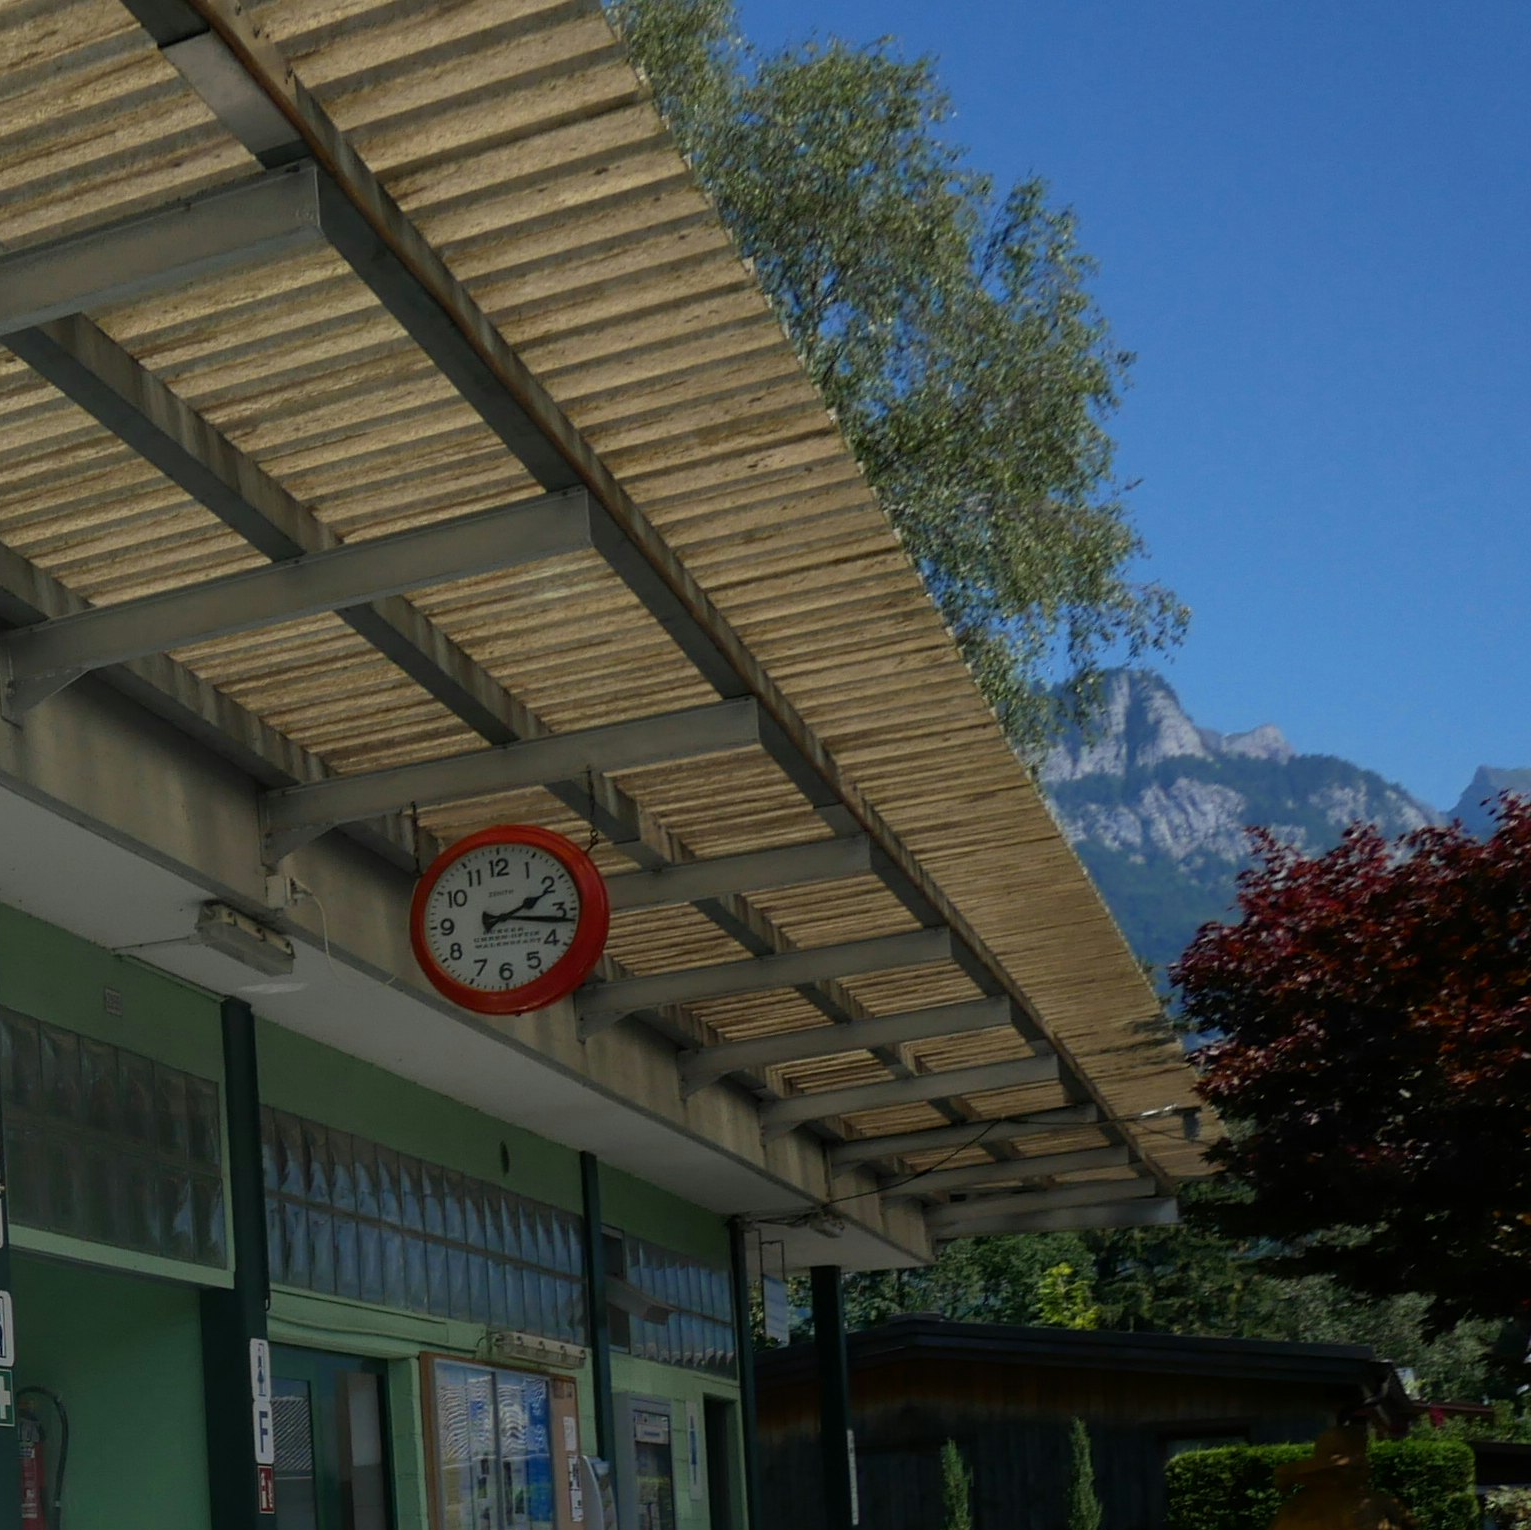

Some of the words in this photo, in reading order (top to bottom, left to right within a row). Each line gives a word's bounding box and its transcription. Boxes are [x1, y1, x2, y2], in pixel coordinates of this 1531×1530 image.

[489, 858, 509, 877] 12
[524, 861, 530, 879] 1
[467, 868, 481, 887] 11
[541, 876, 556, 894] 2
[447, 889, 468, 908] 10
[552, 902, 568, 920] 3
[440, 918, 455, 936] 9
[543, 929, 560, 947] 4
[449, 942, 463, 961] 8
[526, 951, 542, 970] 5
[473, 959, 488, 977] 7
[498, 962, 514, 981] 6
[258, 1410, 268, 1453] F
